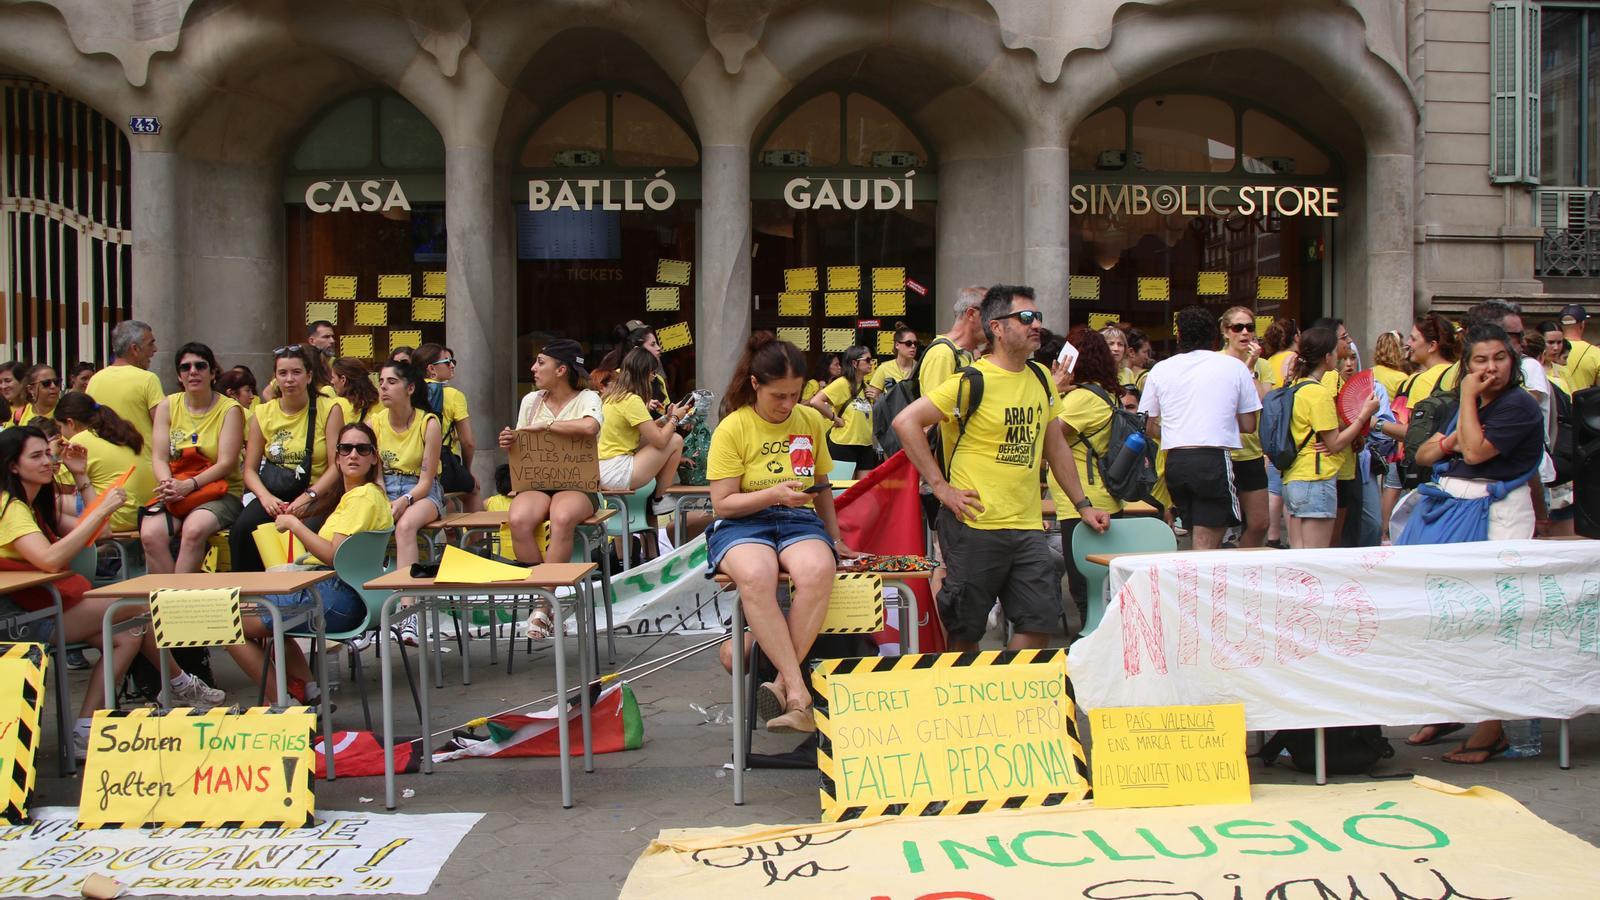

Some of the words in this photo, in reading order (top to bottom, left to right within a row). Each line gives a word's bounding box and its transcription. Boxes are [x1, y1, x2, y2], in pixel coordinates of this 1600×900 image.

[134, 117, 156, 133] 43
[305, 180, 412, 212] CASA
[528, 169, 677, 212] BATLLÓ
[783, 170, 915, 211] GAUDÍ
[1069, 184, 1232, 216] SIMBOLIC
[1237, 185, 1340, 218] STORE
[566, 268, 624, 281] TICKETS
[1004, 406, 1026, 426] ARA
[1027, 406, 1034, 425] O
[520, 452, 533, 461] A
[540, 452, 560, 463] LES
[563, 453, 594, 463] AULES
[761, 441, 790, 456] SOS
[511, 466, 581, 481] VERGONYA
[794, 466, 815, 477] CGT
[530, 481, 545, 489] DE
[829, 682, 910, 716] DECRET
[935, 672, 1064, 707] D'INCLUSIÓ
[1102, 714, 1117, 729] EL
[1126, 711, 1152, 729] PAÍS
[1160, 710, 1216, 730] VALENCIÀ
[97, 723, 182, 753] Sobren
[838, 723, 902, 750] SONA
[1107, 737, 1130, 753] ENS
[1136, 735, 1172, 751] MARCA
[1181, 735, 1194, 750] EL
[1199, 731, 1228, 750] CAMÍ
[841, 751, 934, 801] FALTA
[946, 738, 1079, 796] PERSONAL
[1116, 762, 1171, 785] DIGNITAT
[1176, 762, 1193, 783] NO
[1196, 761, 1209, 783] ES
[96, 769, 176, 811] falten
[193, 765, 271, 796] MANS
[902, 801, 1450, 874] INCLUSIÓ
[127, 876, 242, 889] ESCOLES
[244, 876, 343, 889] DIGNES
